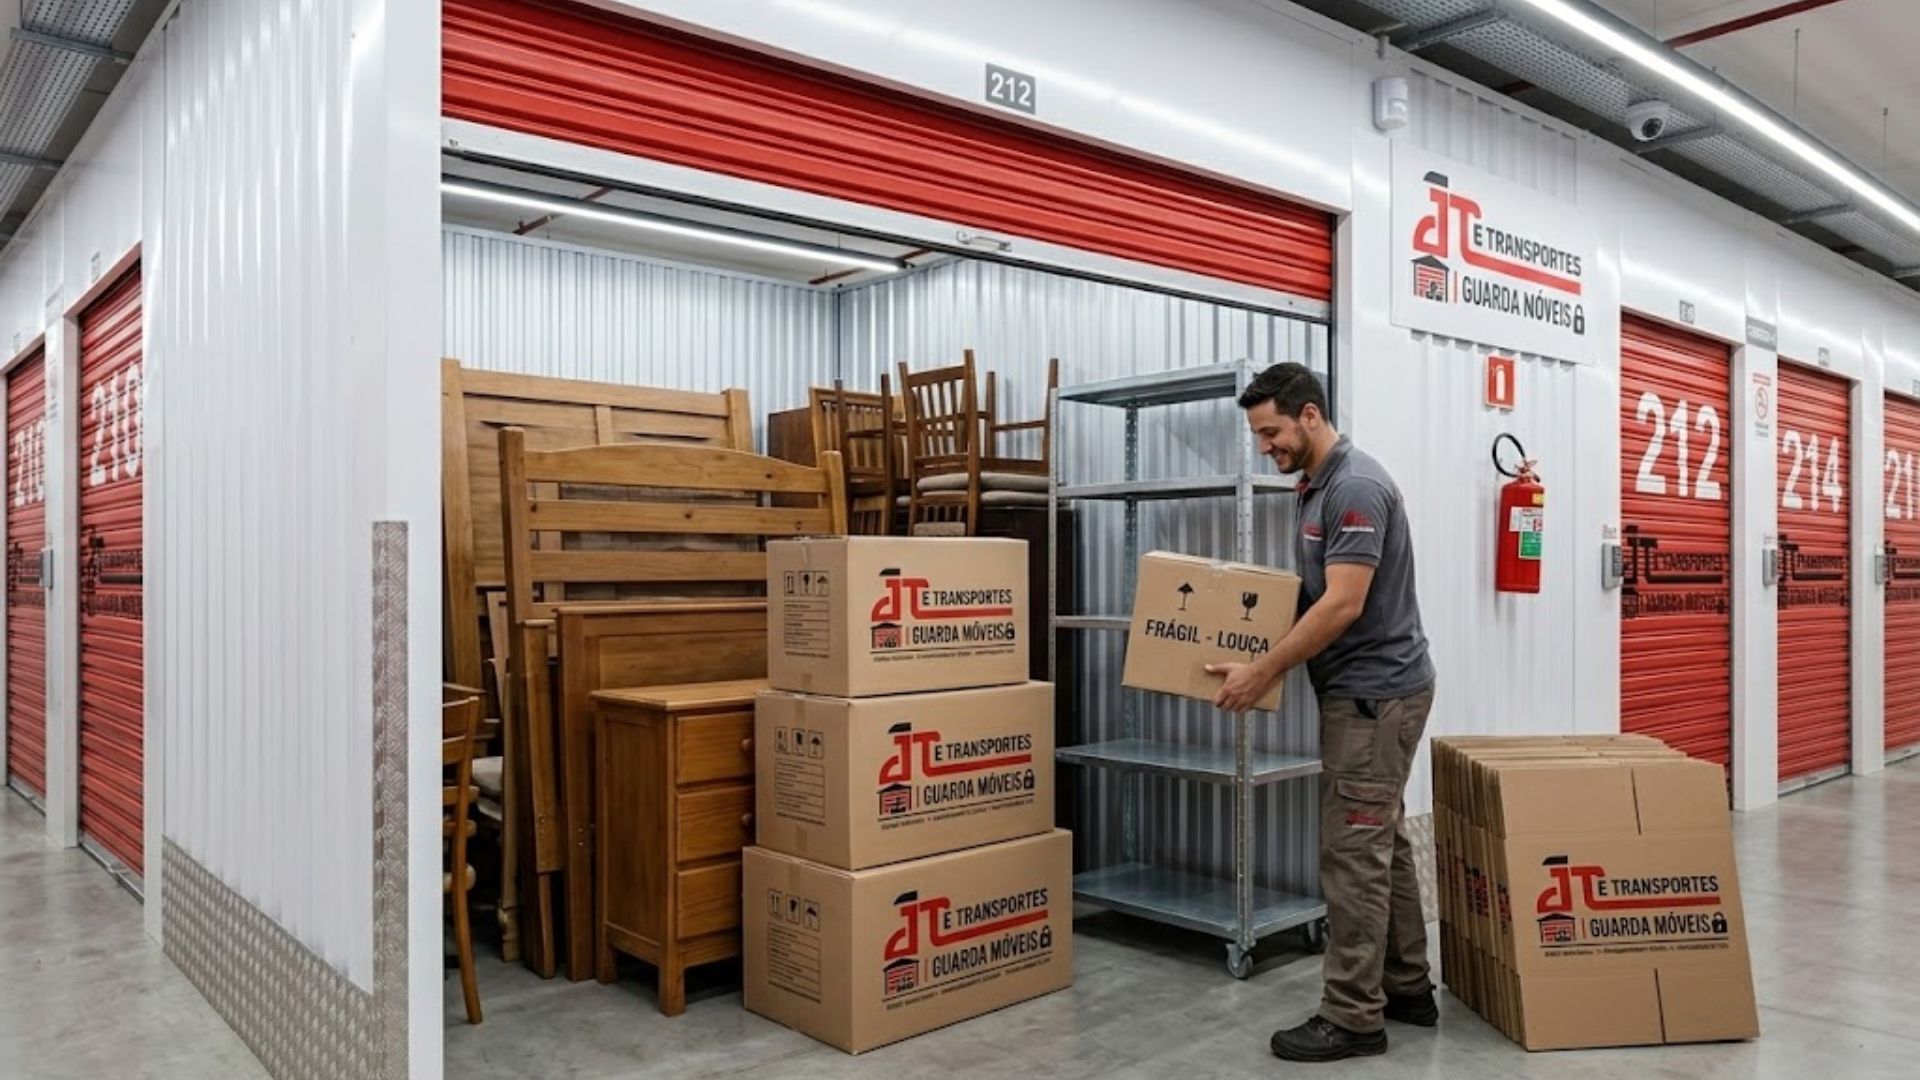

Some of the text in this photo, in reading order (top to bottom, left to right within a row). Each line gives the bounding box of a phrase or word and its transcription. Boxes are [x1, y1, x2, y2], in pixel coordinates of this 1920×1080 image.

[991, 72, 1031, 106] 212
[1473, 223, 1482, 247] E
[1486, 227, 1582, 277] TRANSPORTES
[1462, 276, 1520, 316] GUARDA
[1635, 391, 1722, 500] 212
[1782, 430, 1843, 514] 214
[1886, 449, 1920, 520] 21
[922, 590, 931, 606] E
[933, 588, 1013, 606] TRANSPORTES
[912, 621, 1005, 645] GUARDA MÓVEIS
[1145, 618, 1201, 645] FRÁGIL
[1217, 630, 1270, 660] LOUÇA
[935, 744, 943, 761] E
[947, 733, 1032, 759] TRANSPORTES
[923, 777, 974, 806] GUARDA
[978, 771, 1023, 797] MÓVEIS
[1598, 880, 1608, 896] E
[1611, 875, 1719, 896] TRANSPORTES
[944, 911, 952, 929] E
[956, 888, 1048, 926] TRANSPORTES
[1590, 911, 1711, 938] GUARDA MÓVEIS
[932, 945, 987, 978] GUARDA
[990, 930, 1038, 962] MÓVEIS
